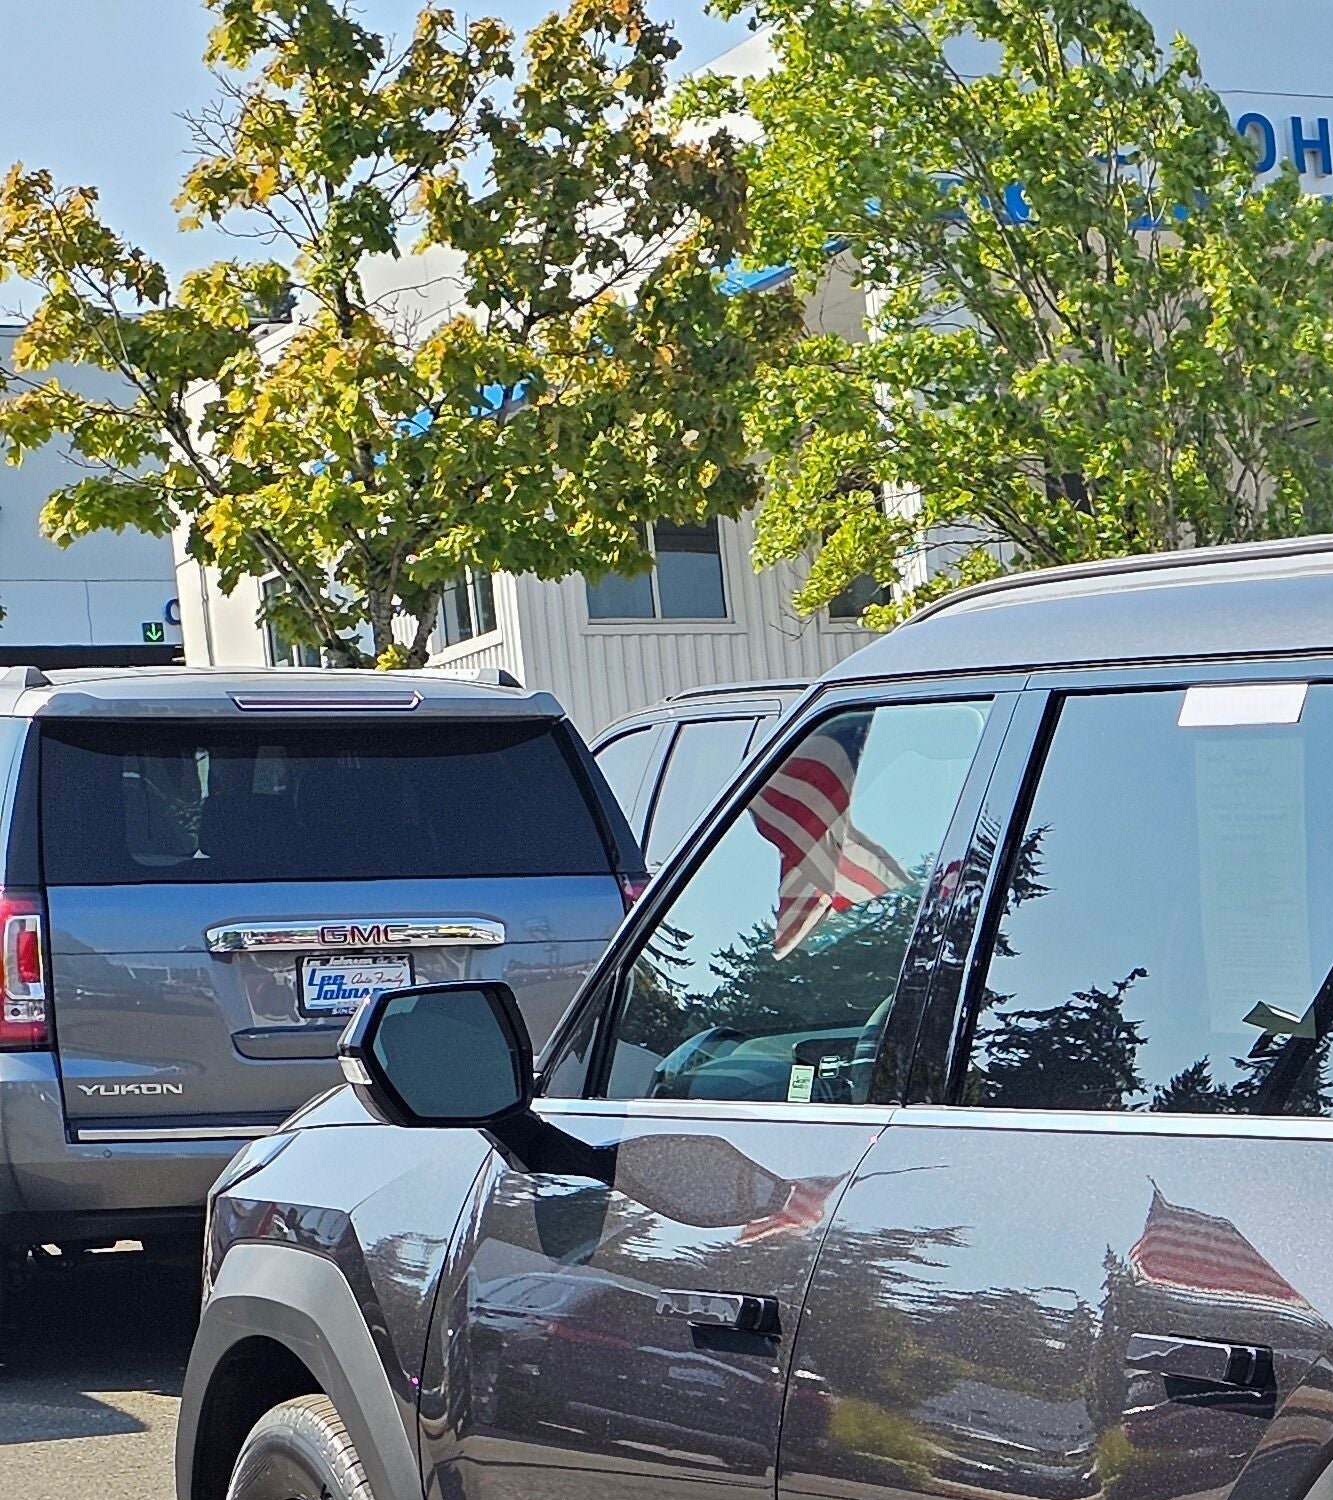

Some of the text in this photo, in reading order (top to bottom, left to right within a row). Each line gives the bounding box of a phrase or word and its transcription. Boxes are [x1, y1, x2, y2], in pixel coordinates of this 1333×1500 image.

[319, 925, 411, 945] GMC
[308, 968, 346, 986] Lee
[77, 1083, 183, 1096] YUKON
